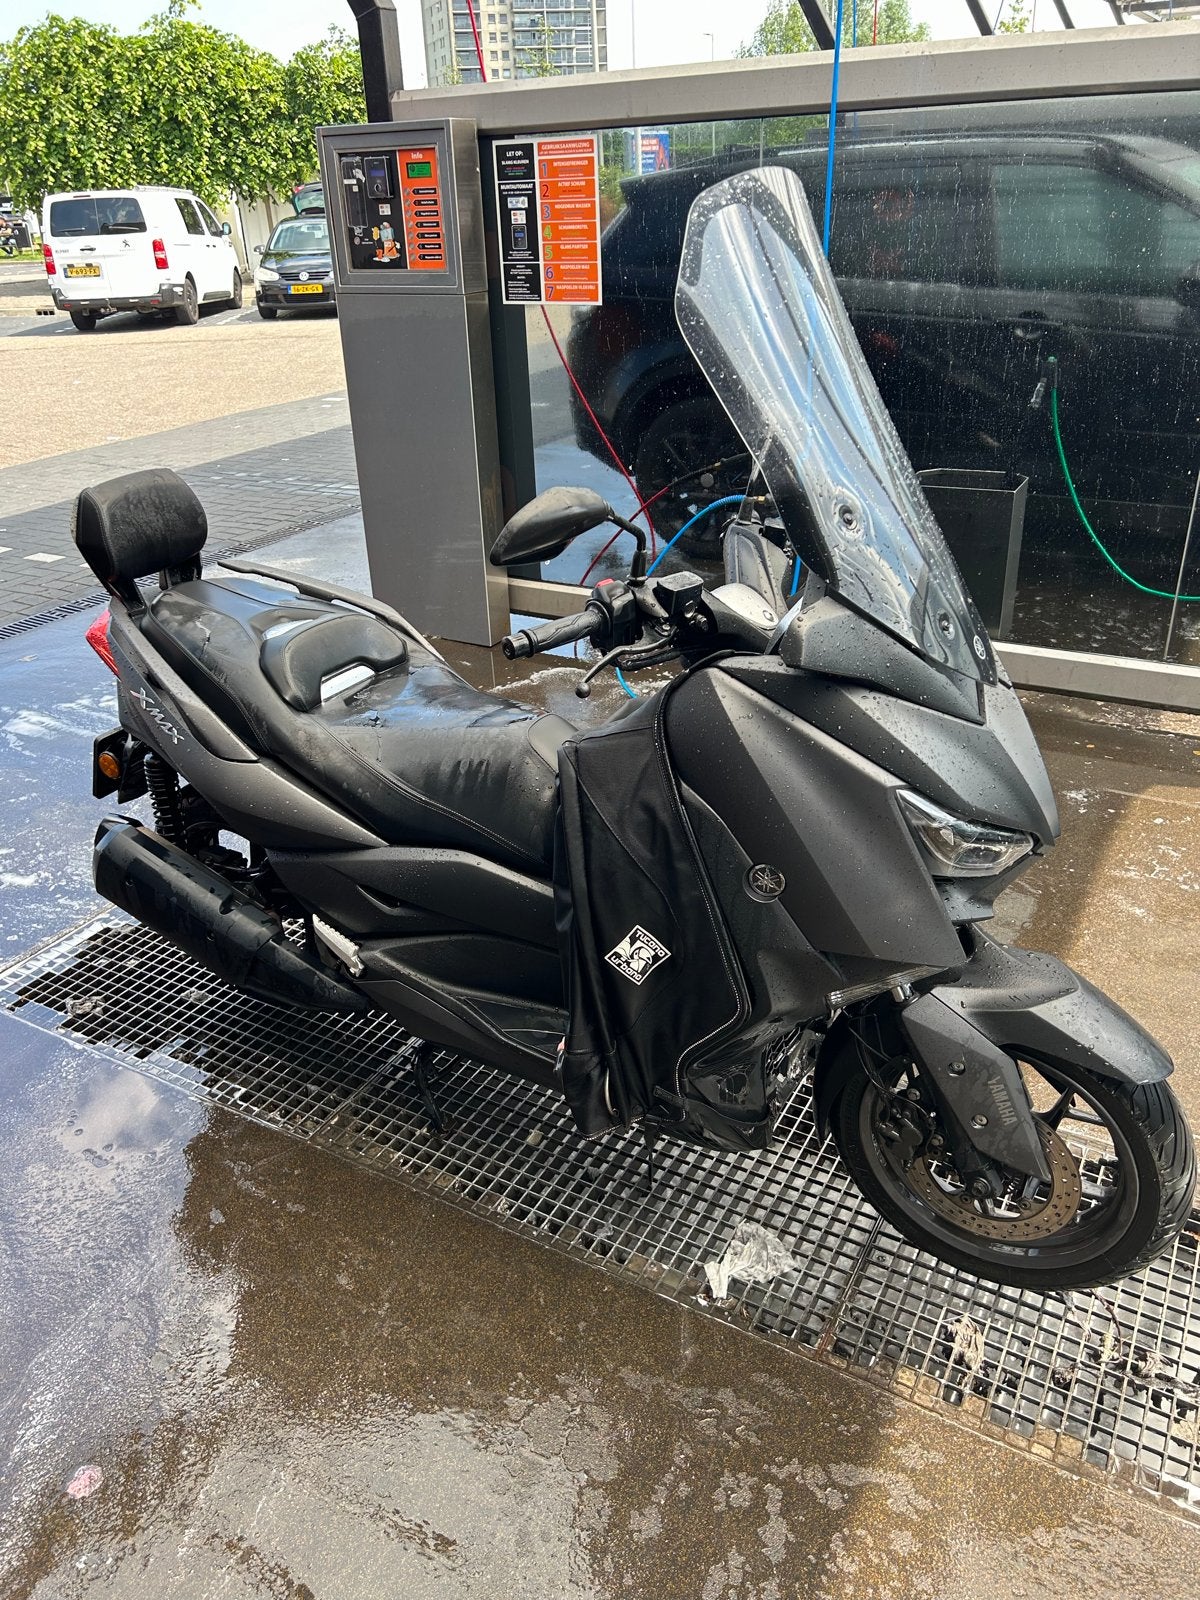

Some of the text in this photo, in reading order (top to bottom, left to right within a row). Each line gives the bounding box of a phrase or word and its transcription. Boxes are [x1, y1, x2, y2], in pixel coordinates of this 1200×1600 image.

[541, 162, 548, 177] 1
[542, 184, 550, 198] 2
[543, 204, 551, 219] 3
[543, 224, 552, 240] 4
[544, 244, 553, 260] 5
[545, 266, 554, 280] 6
[546, 285, 555, 300] 7
[987, 1075, 1018, 1126] YAMAHA
